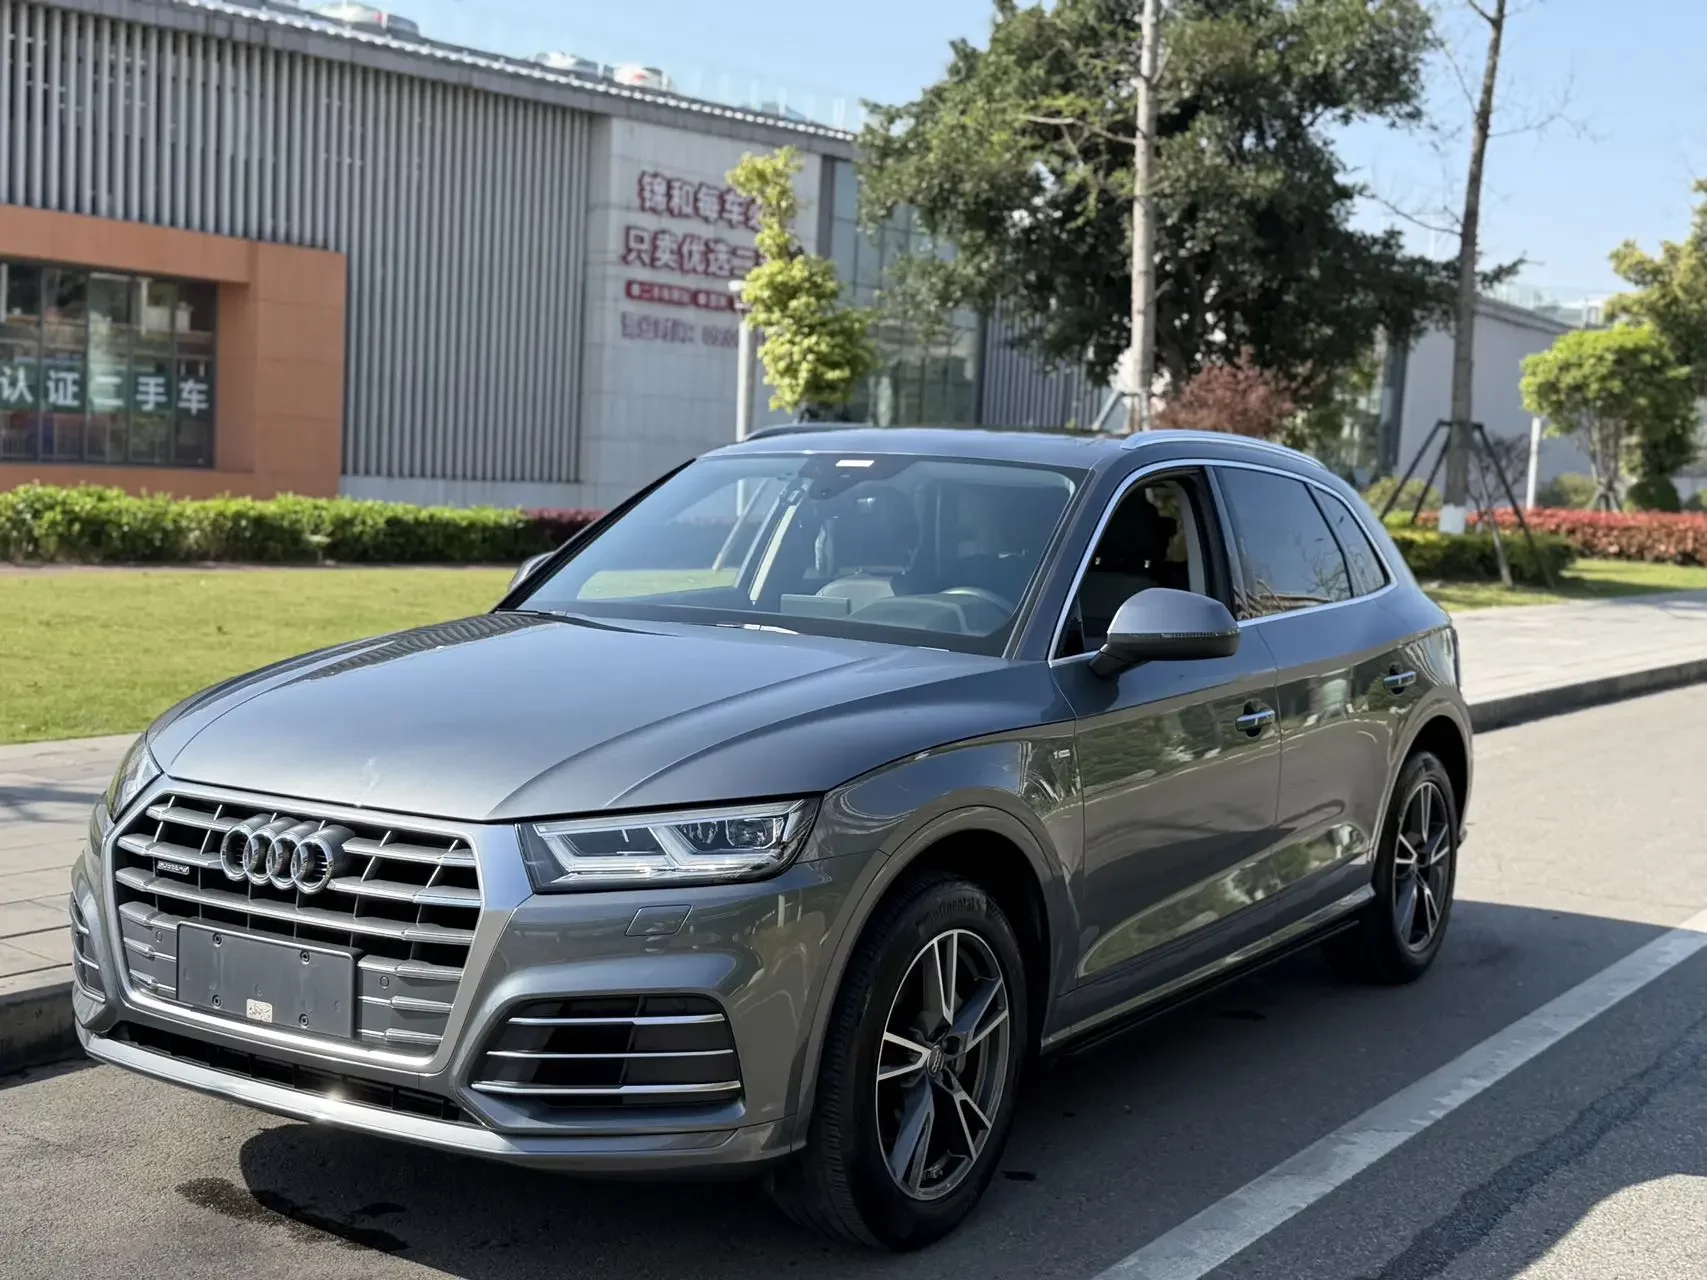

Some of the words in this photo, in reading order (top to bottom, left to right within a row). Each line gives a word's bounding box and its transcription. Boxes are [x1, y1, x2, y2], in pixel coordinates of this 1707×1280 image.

[622, 225, 769, 277] 只卖优选二
[0, 366, 209, 415] 认证二手车
